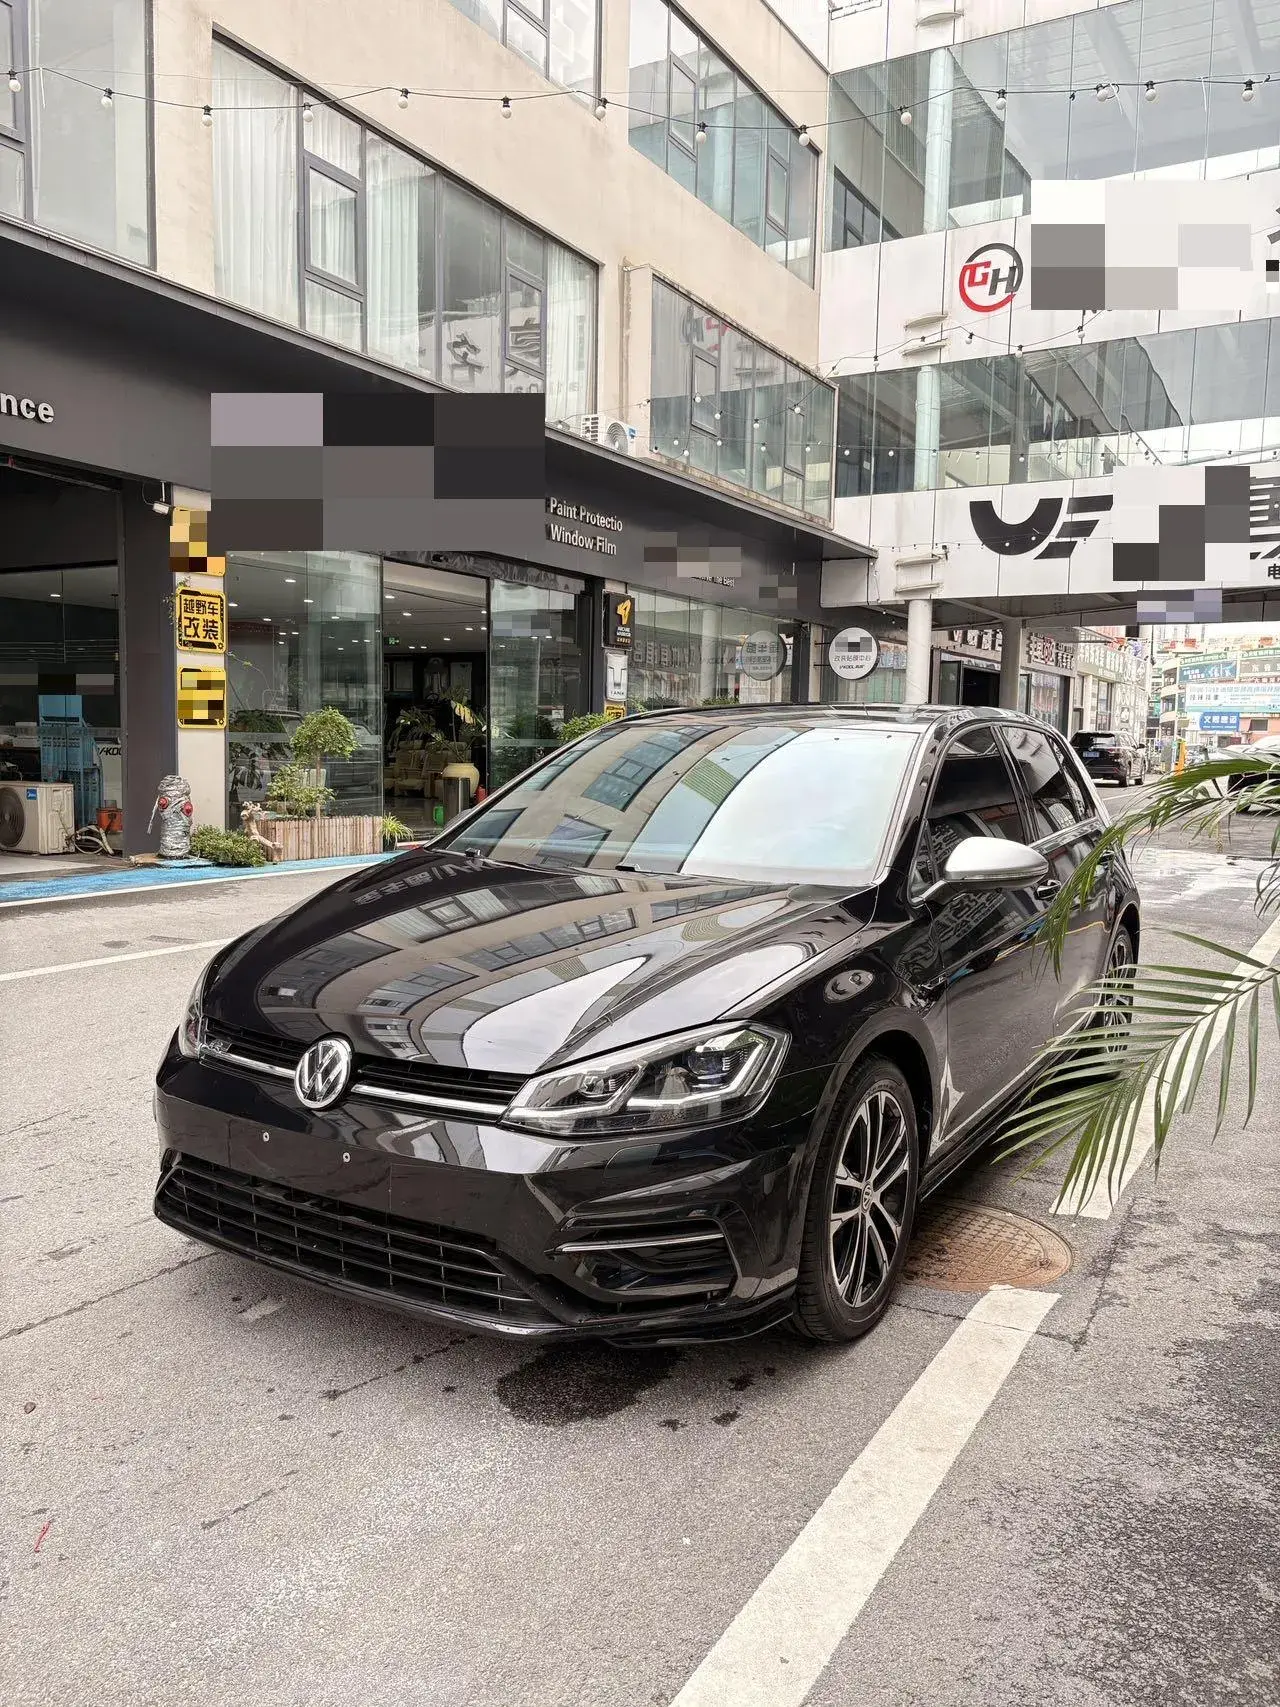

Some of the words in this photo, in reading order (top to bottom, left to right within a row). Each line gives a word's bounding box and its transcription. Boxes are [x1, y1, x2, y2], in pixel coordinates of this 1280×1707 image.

[0, 392, 55, 423] nce
[550, 496, 578, 519] Paint
[580, 505, 623, 532] Protectio
[550, 523, 595, 550] Window
[596, 535, 617, 555] Film
[183, 598, 219, 617] 越野车
[183, 617, 219, 641] 改装
